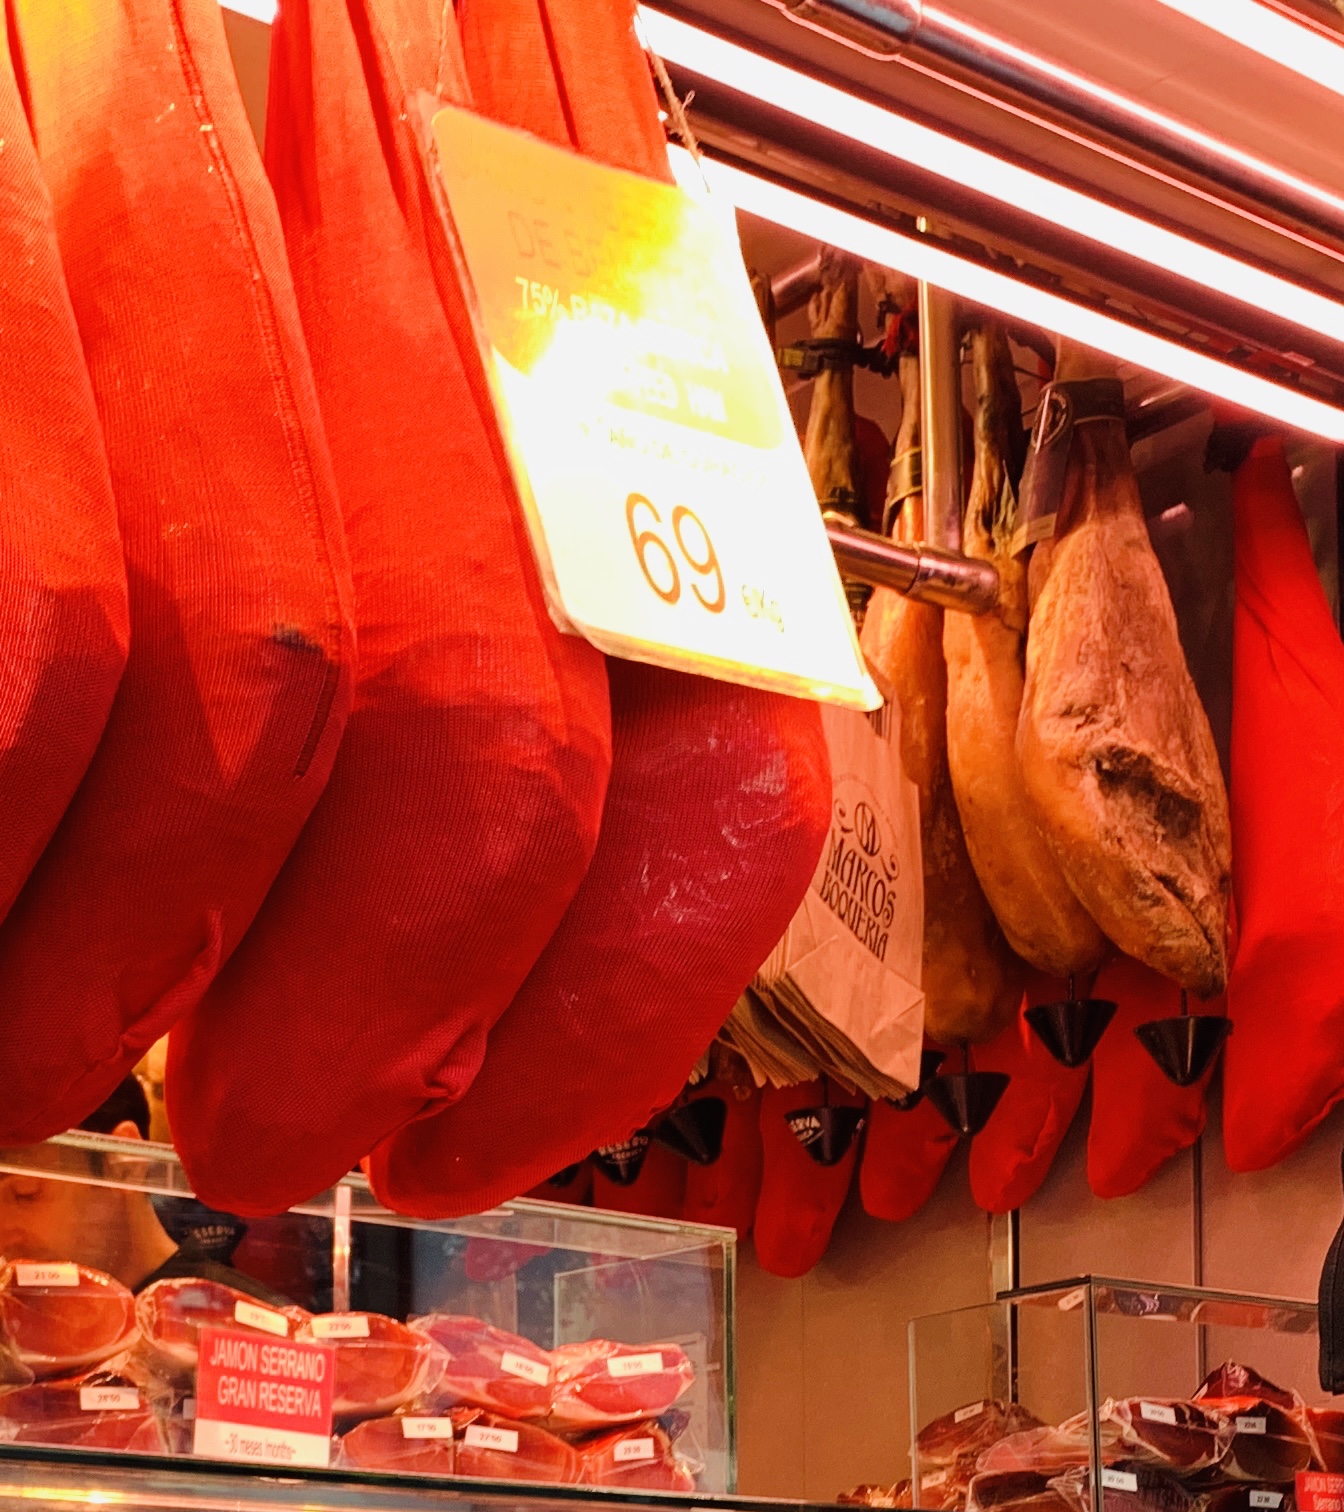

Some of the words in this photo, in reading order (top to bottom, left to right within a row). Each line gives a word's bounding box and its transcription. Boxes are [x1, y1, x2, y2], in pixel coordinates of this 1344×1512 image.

[625, 492, 726, 614] 69
[827, 827, 896, 928] MARCOS
[820, 870, 888, 962] BOQUERIA
[209, 1338, 259, 1372] JAMON
[259, 1344, 326, 1383] SERRANO
[217, 1375, 257, 1408] GRAN
[258, 1382, 322, 1418] RESERVA
[1313, 1494, 1341, 1512] Serrano
